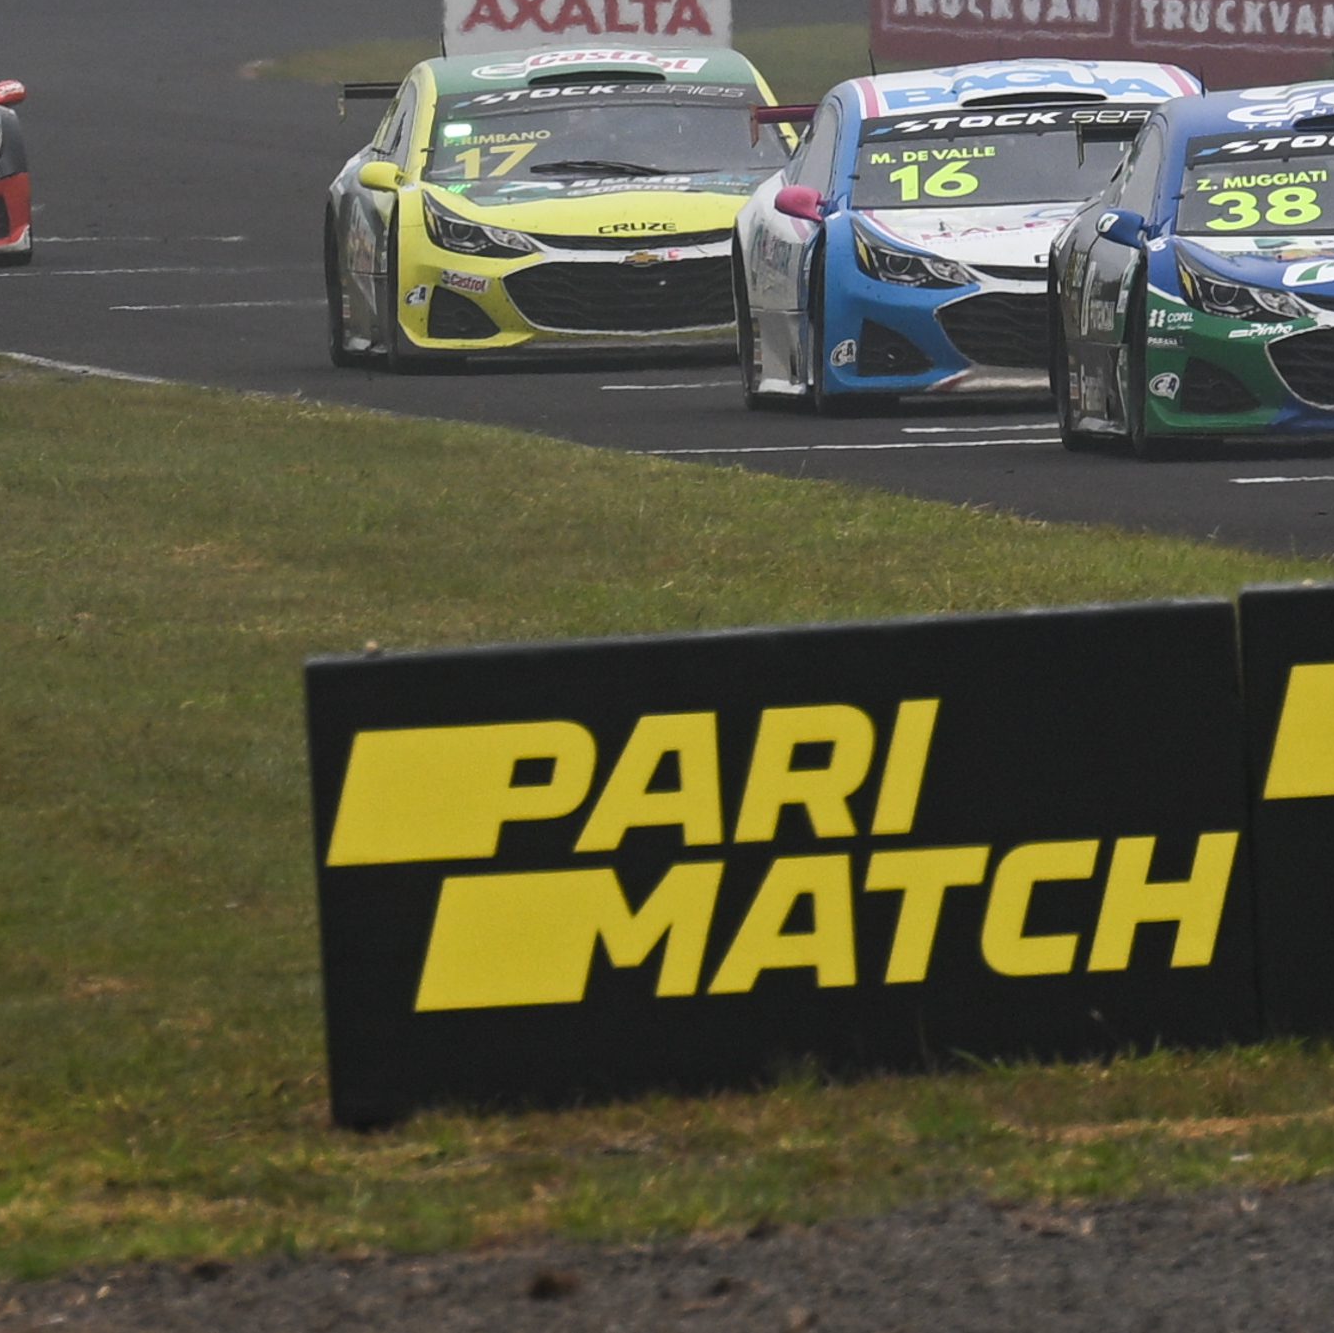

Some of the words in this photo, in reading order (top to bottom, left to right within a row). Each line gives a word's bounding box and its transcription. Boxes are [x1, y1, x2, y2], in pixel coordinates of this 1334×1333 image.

[470, 85, 620, 104] STOCK
[621, 84, 746, 98] SERIES
[892, 111, 1064, 132] STOCK
[455, 142, 537, 180] 17
[871, 153, 896, 164] M.
[903, 151, 928, 162] DE
[932, 147, 996, 160] VALLE
[889, 161, 979, 201] 16
[1196, 179, 1218, 191] Z.
[1223, 170, 1327, 189] MUGGIATI
[1206, 186, 1322, 231] 38
[599, 222, 677, 234] CRUZE
[326, 698, 939, 864] PARI
[414, 830, 1239, 1011] MATCH
